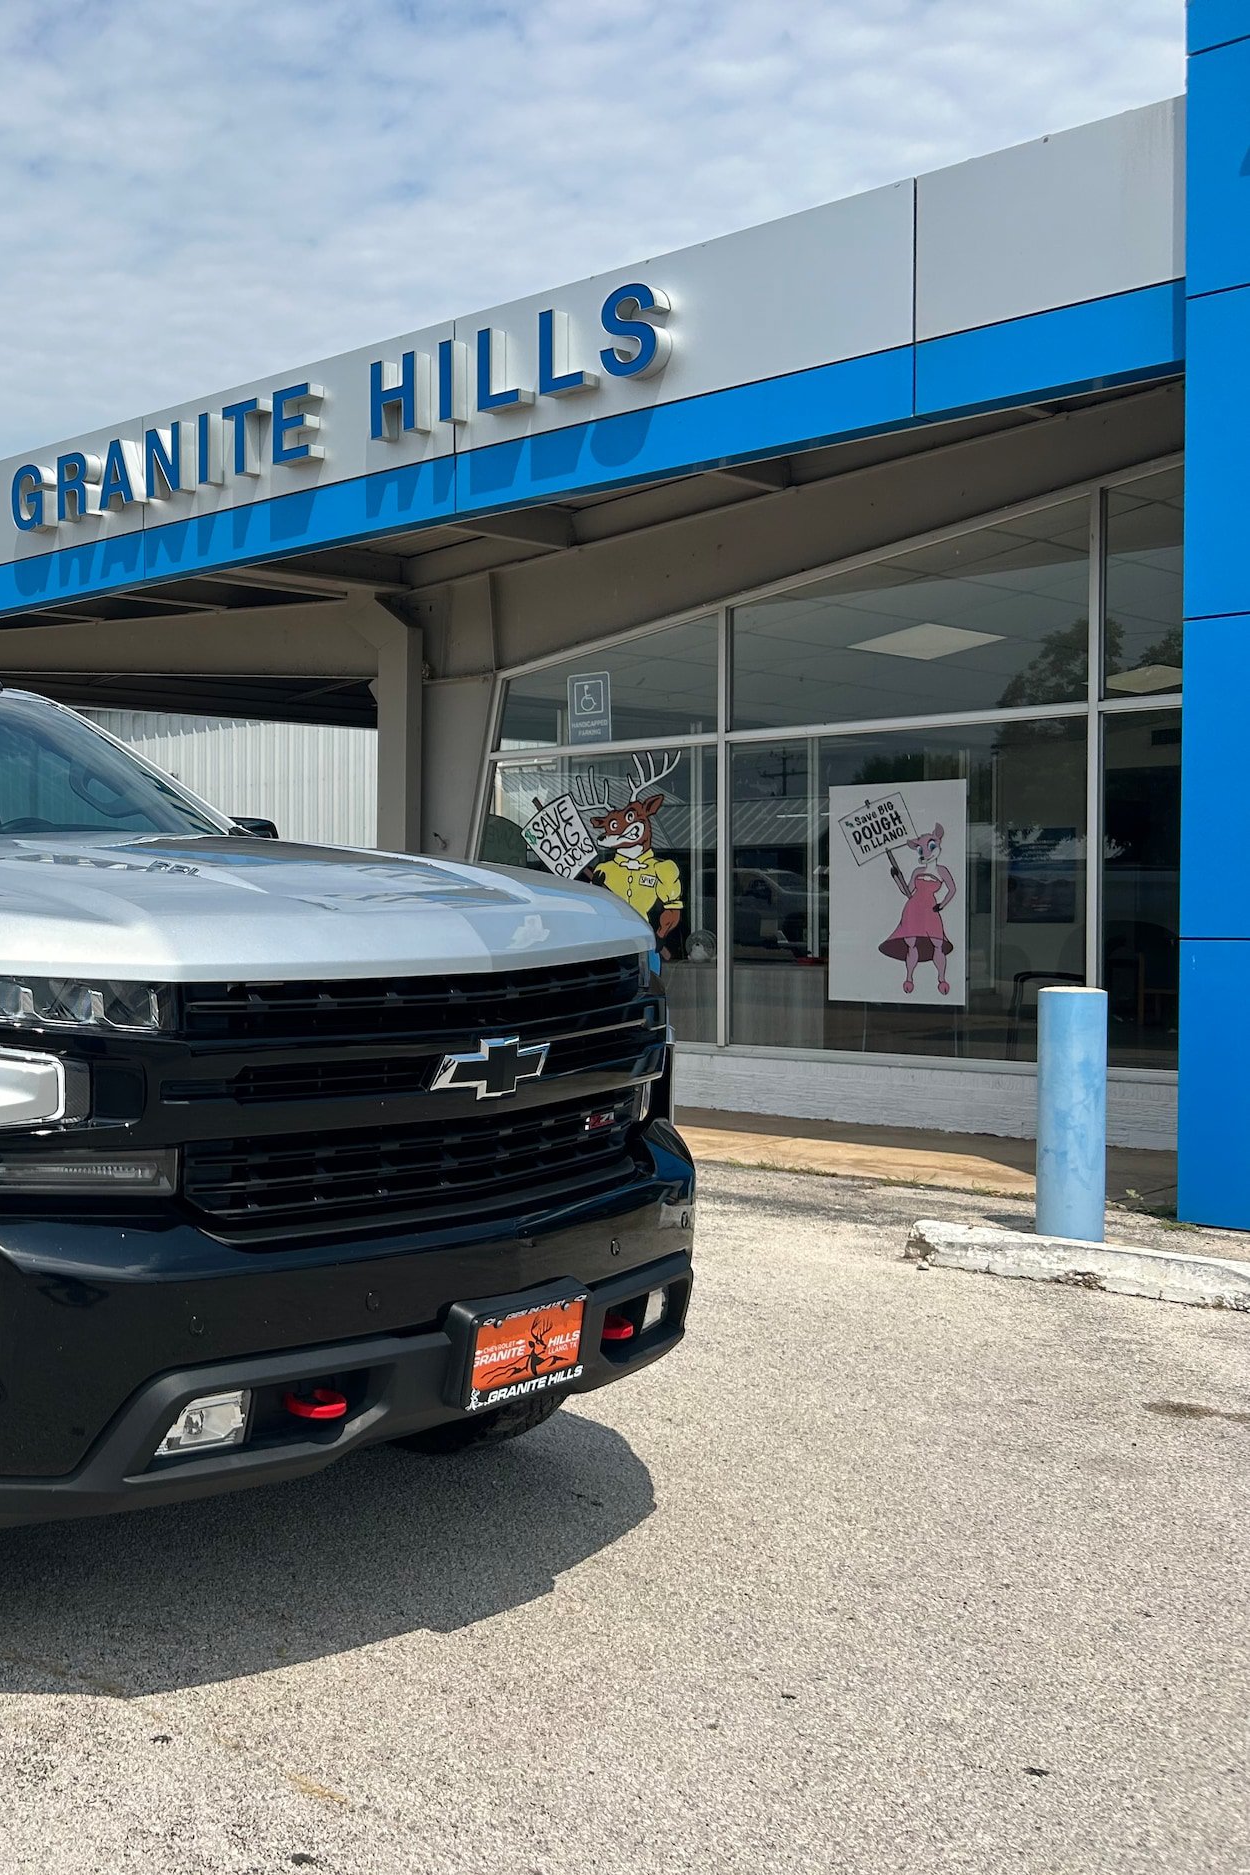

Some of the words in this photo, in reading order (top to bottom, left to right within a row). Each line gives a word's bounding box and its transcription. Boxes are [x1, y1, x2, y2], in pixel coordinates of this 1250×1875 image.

[12, 382, 324, 533] GRANITE
[370, 282, 672, 442] HILLS
[532, 800, 574, 839] SAVE
[852, 810, 903, 846] DOUGH
[854, 810, 878, 826] Save
[877, 801, 894, 815] BIG
[539, 822, 580, 861] BIG
[871, 825, 908, 849] LLANO!
[555, 837, 594, 879] BUCKS
[483, 1340, 516, 1355] CHEVROLET
[547, 1330, 581, 1348] HILLS
[487, 1376, 547, 1405] GRANITE
[547, 1365, 584, 1387] HILLS
